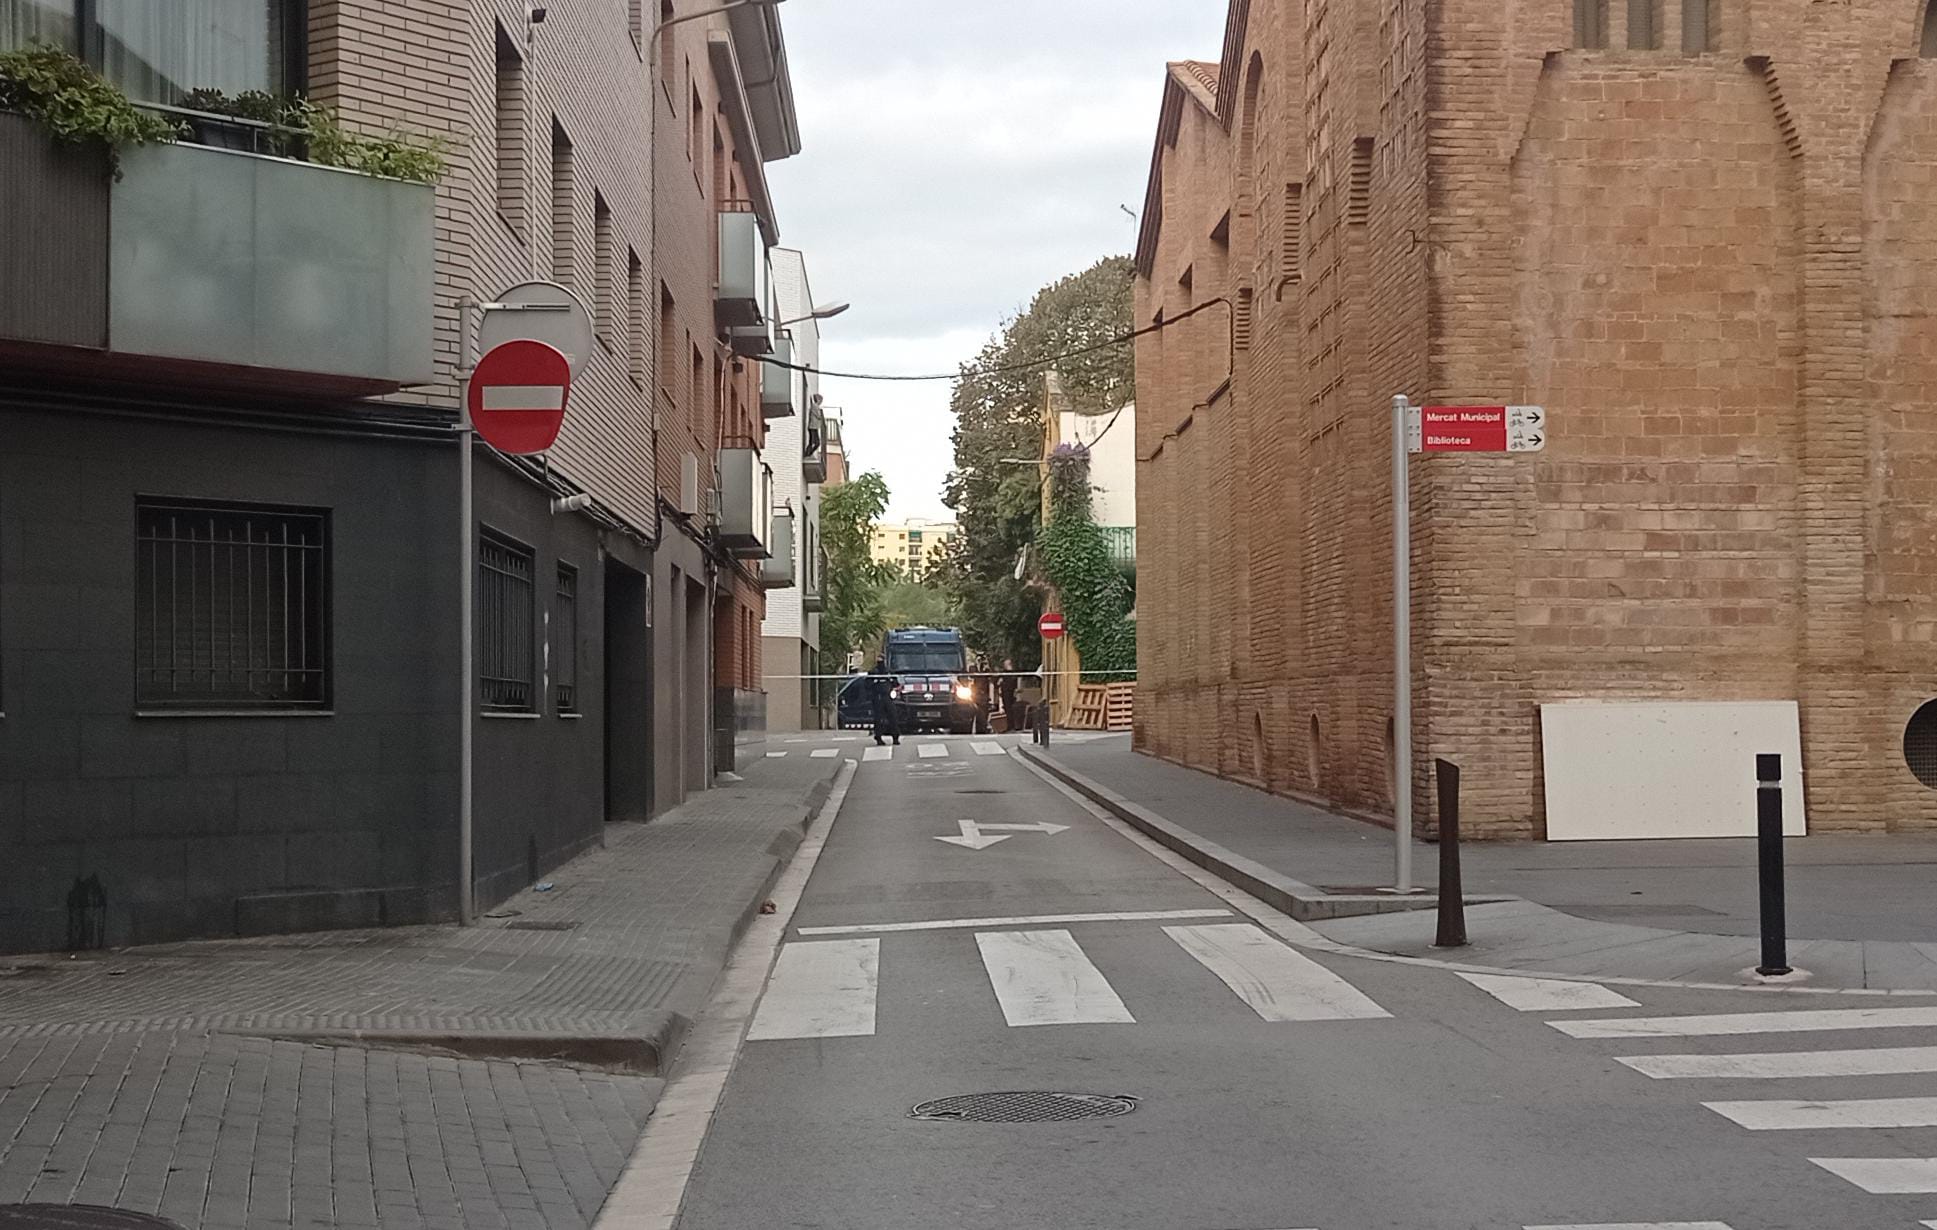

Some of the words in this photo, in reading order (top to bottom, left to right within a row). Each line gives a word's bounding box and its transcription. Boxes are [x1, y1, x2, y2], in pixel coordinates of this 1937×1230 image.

[1427, 413, 1457, 422] Mercat
[1460, 412, 1500, 423] Municipal
[1427, 436, 1471, 445] Biblioteca
